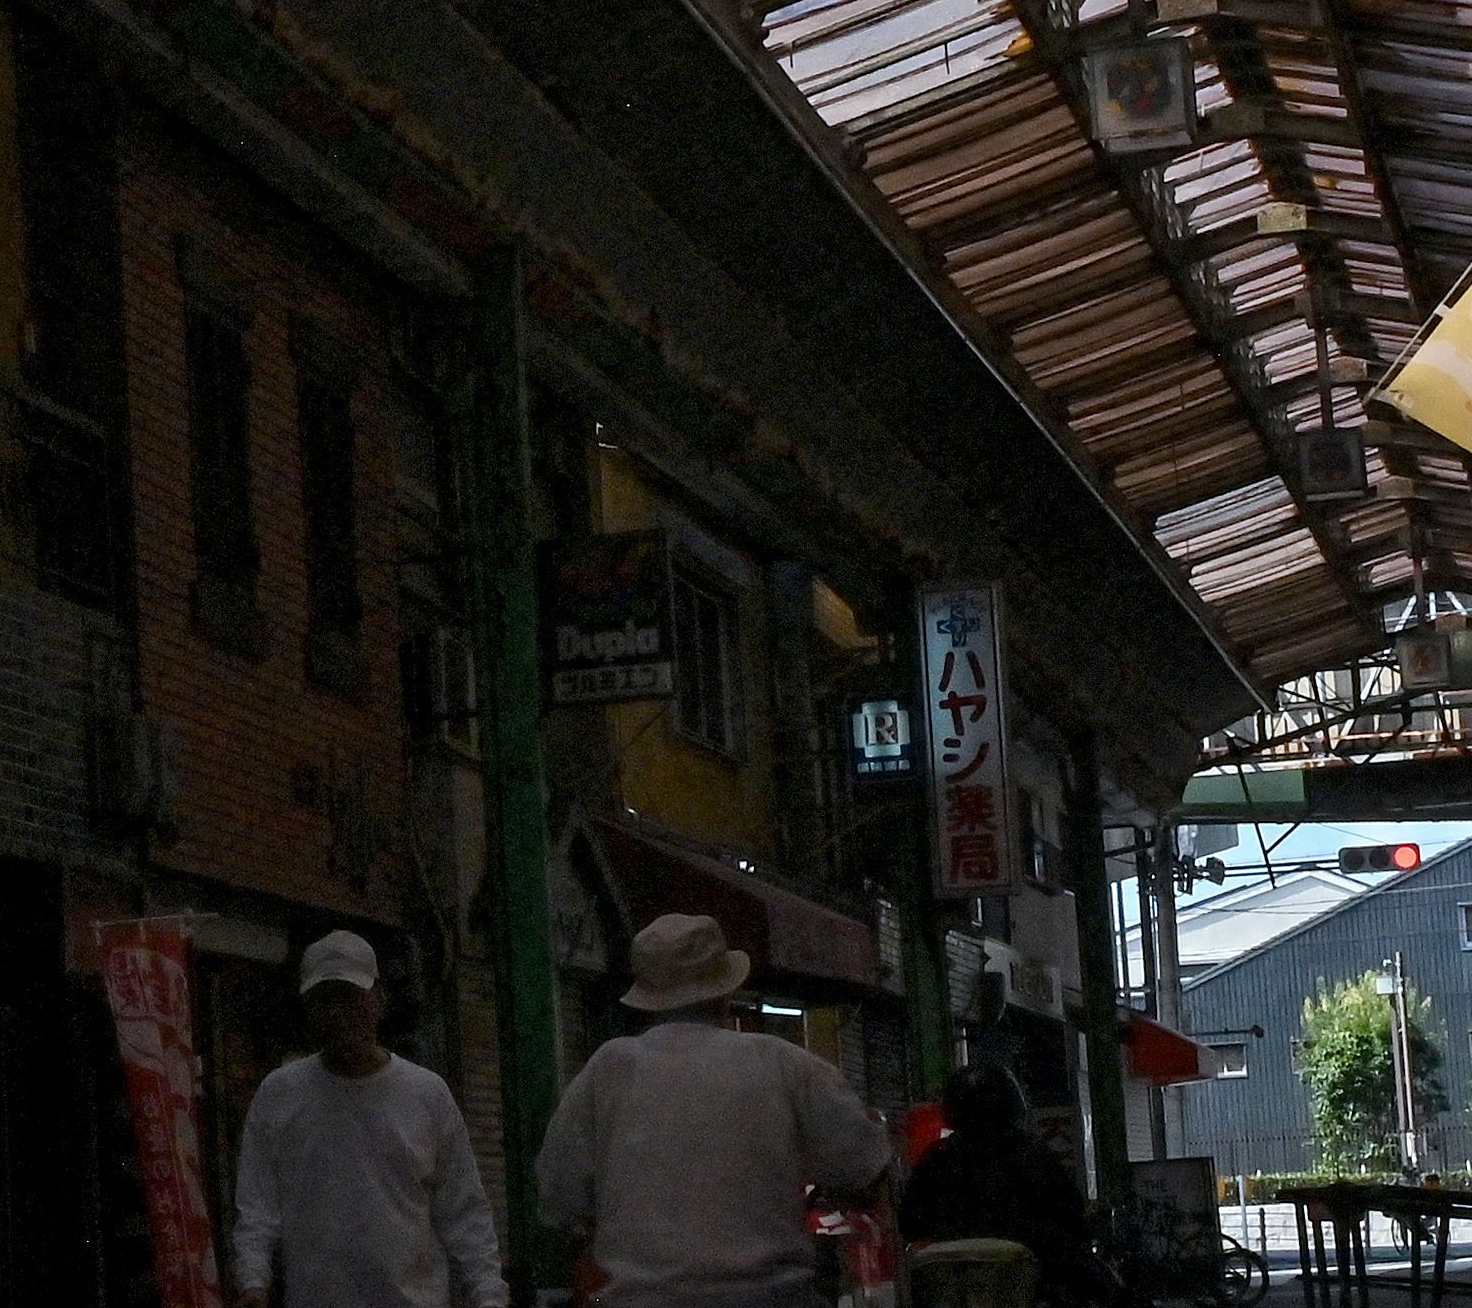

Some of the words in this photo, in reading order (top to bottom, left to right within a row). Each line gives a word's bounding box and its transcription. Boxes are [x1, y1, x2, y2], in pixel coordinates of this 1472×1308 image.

[937, 650, 1000, 885] ハヤシ薬局
